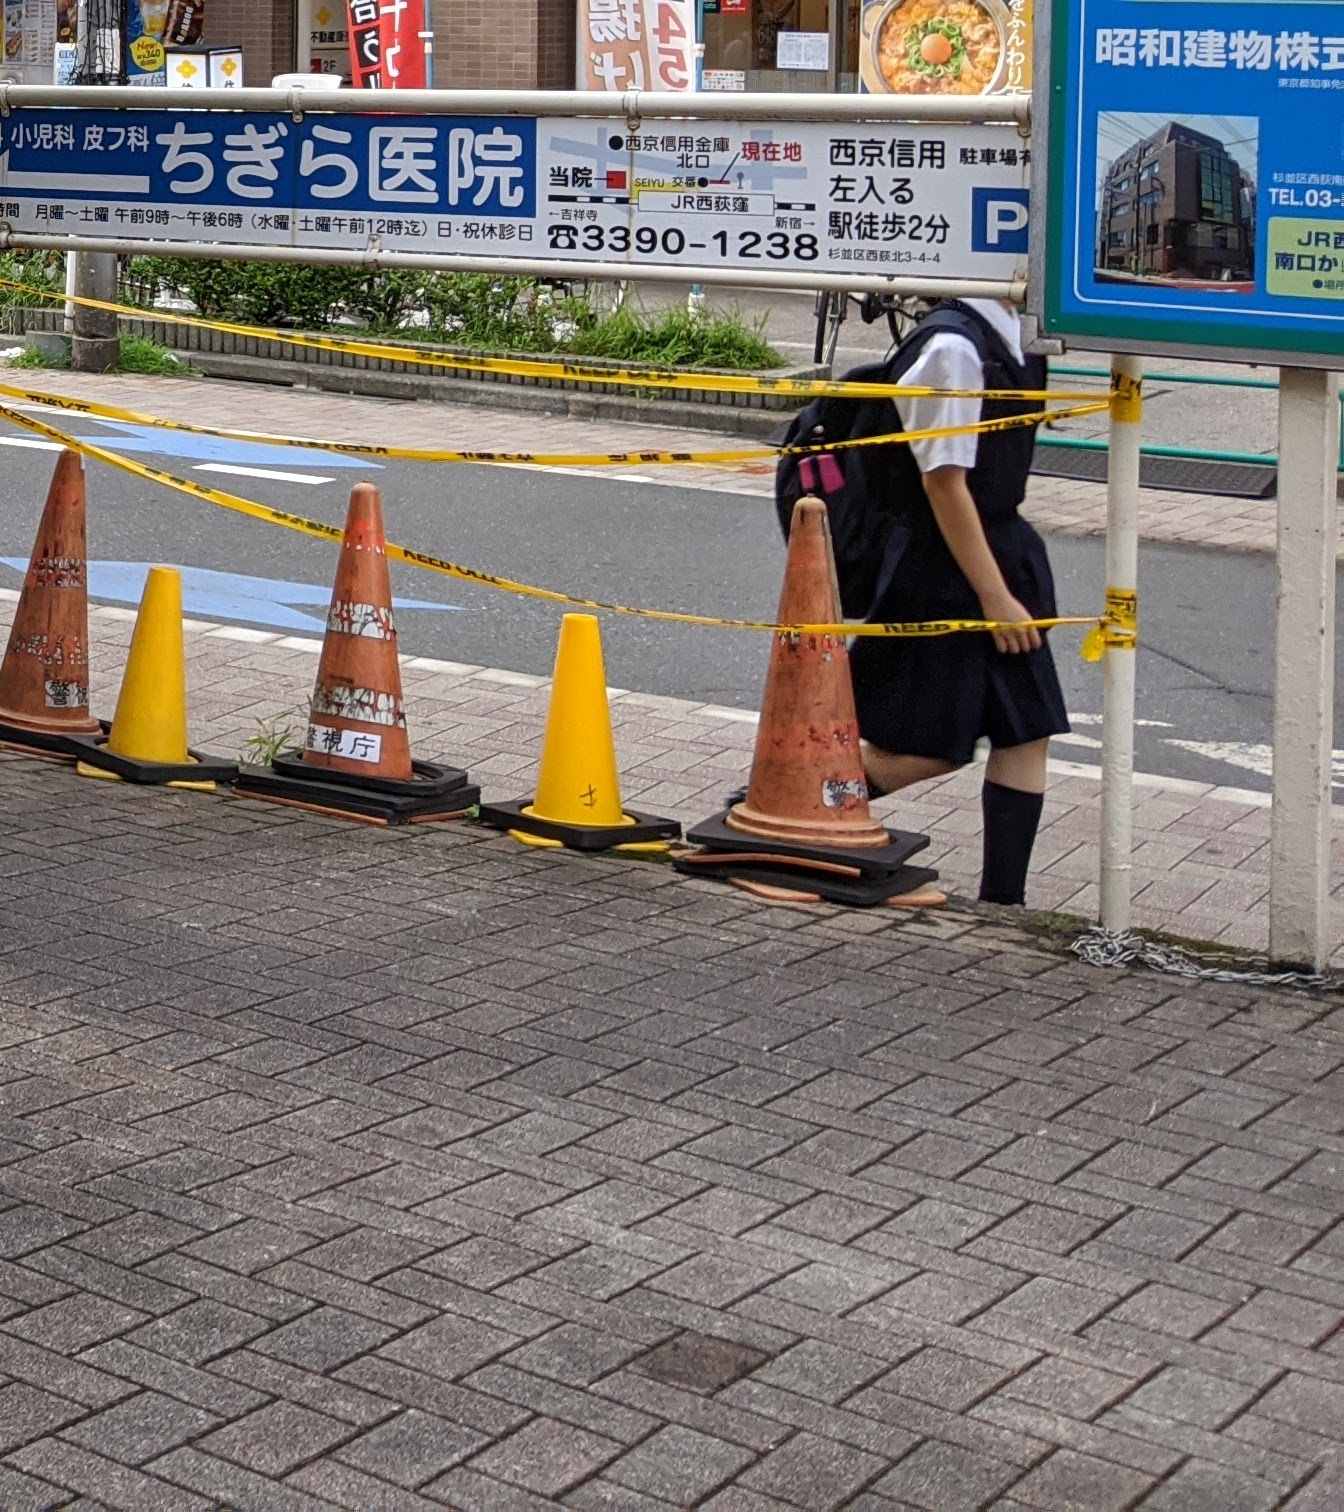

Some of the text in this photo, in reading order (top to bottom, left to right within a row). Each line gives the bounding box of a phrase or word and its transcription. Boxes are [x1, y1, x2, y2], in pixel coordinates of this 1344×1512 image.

[323, 61, 337, 72] 2F
[12, 123, 75, 152] 小児科
[83, 125, 150, 154] 皮フ科
[625, 134, 730, 154] 西京信用金庫
[676, 153, 710, 170] 北口
[741, 140, 803, 163] 現在地
[828, 138, 947, 170] 西京信用
[155, 121, 524, 207] ちぎら医院
[549, 165, 593, 189] 当院
[634, 177, 666, 189] SEIYU
[672, 176, 696, 189] 交番
[1273, 172, 1344, 185] 杉並区西荻南
[828, 174, 915, 205] 左入る
[1269, 188, 1344, 208] TEL.03-
[670, 194, 750, 213] JR西荻窪
[775, 216, 803, 230] 新宿
[827, 211, 951, 245] 駅徒歩2分
[986, 201, 1028, 244] P
[827, 246, 941, 265] 杉並区西荻北3-4-4
[1275, 252, 1344, 273] 南口か
